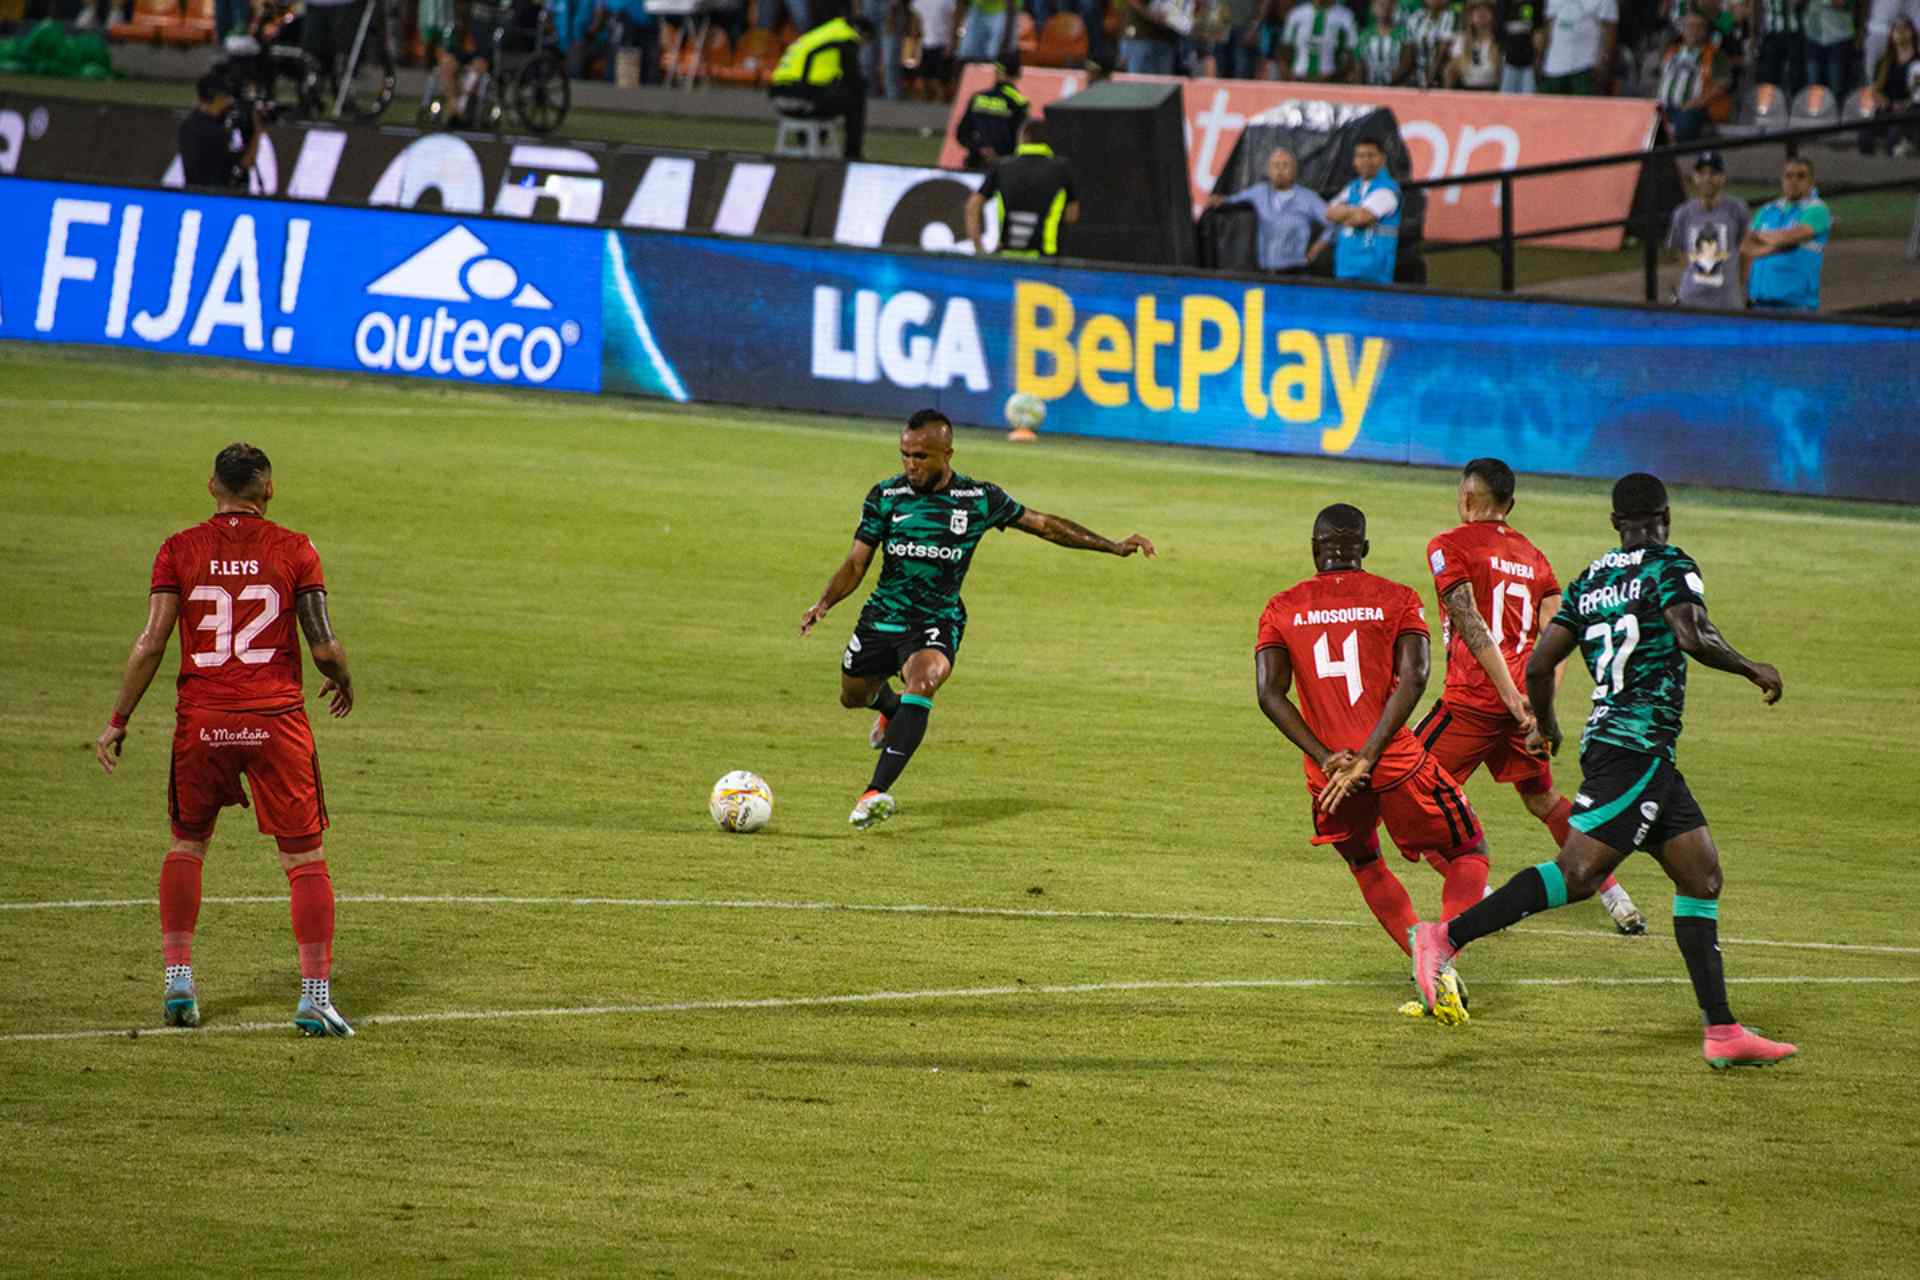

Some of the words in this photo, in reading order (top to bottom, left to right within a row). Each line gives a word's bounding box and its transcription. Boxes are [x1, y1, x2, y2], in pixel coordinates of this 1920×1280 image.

[34, 197, 311, 355] FIJA!
[355, 305, 563, 382] auteco
[811, 285, 992, 393] LIGA
[1014, 281, 1390, 454] BetPlay
[210, 560, 260, 576] F.LEYS
[887, 541, 963, 561] betsson
[188, 584, 280, 668] 32
[1293, 607, 1385, 627] A.MOSQUERA
[1491, 580, 1534, 655] 17
[1313, 629, 1364, 707] 4
[212, 727, 271, 741] Montaña
